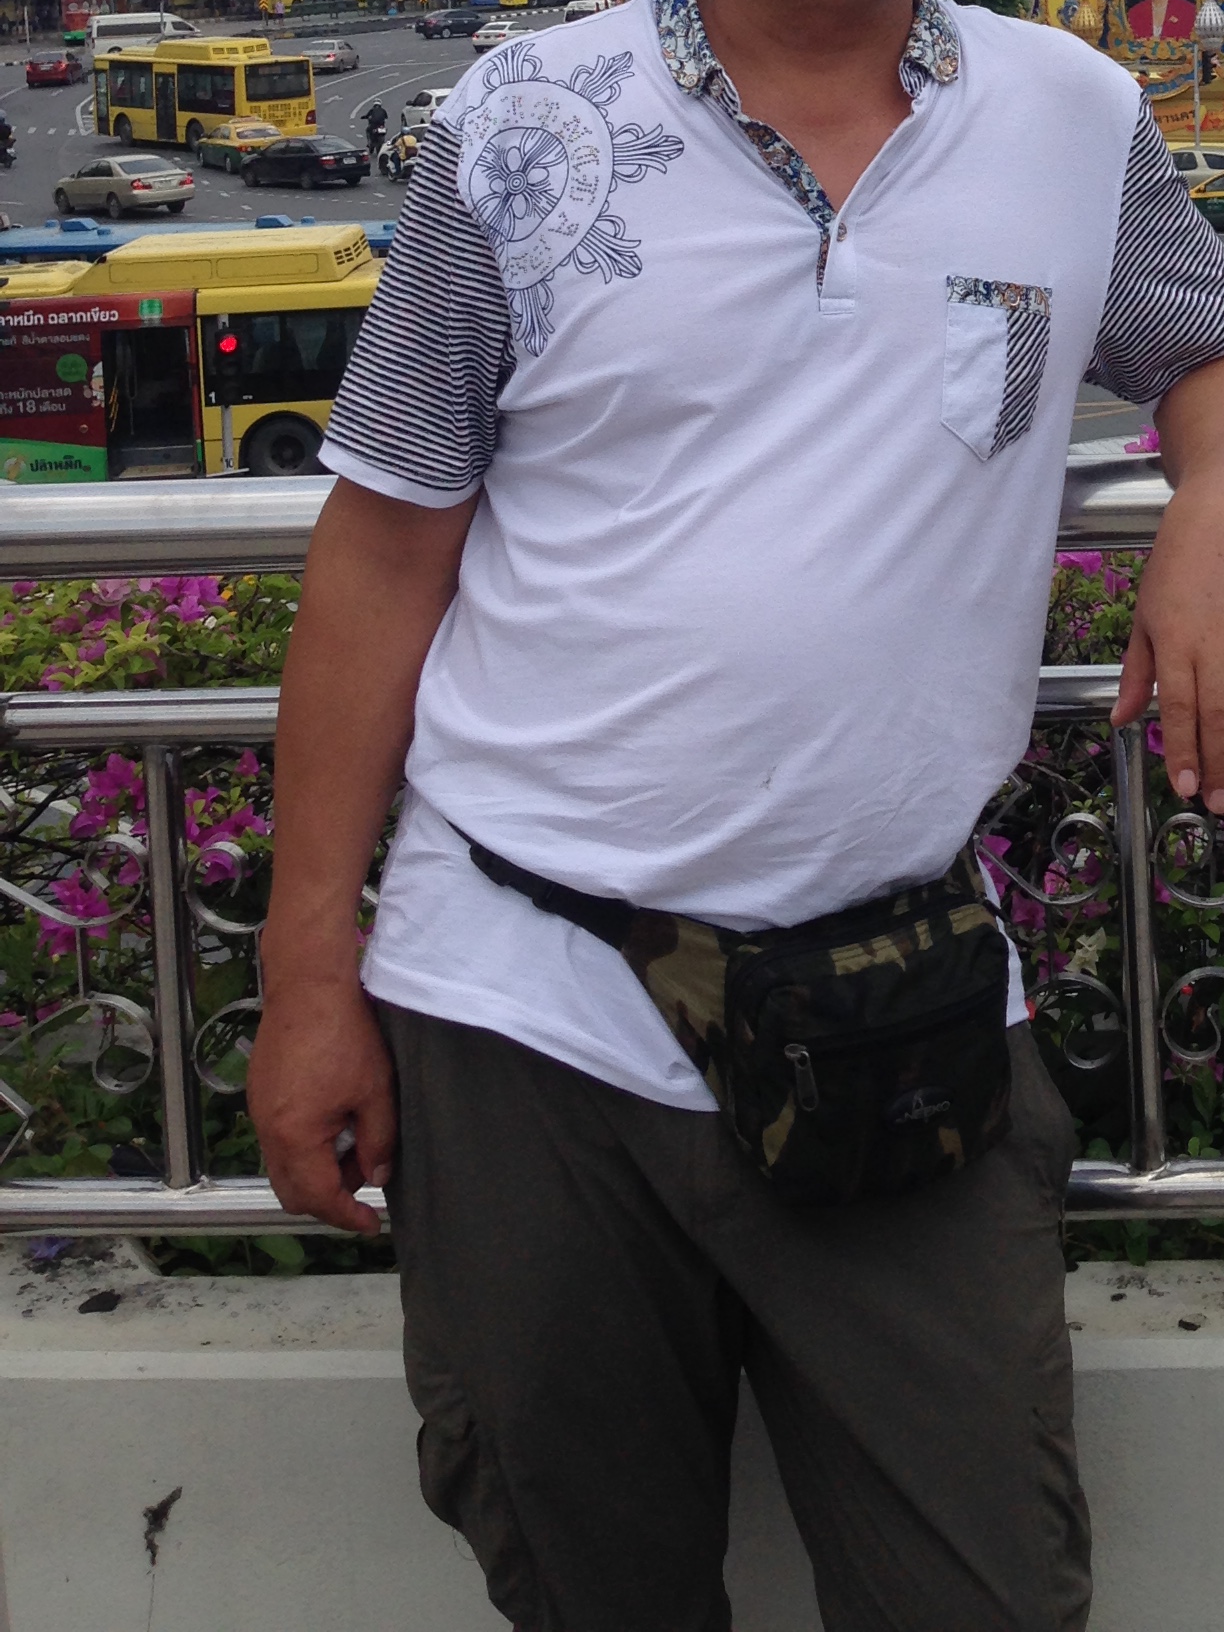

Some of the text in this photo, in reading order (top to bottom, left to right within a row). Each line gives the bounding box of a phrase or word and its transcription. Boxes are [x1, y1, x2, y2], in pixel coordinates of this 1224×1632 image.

[48, 306, 119, 325] ฉลากเขียว
[17, 399, 37, 414] 18
